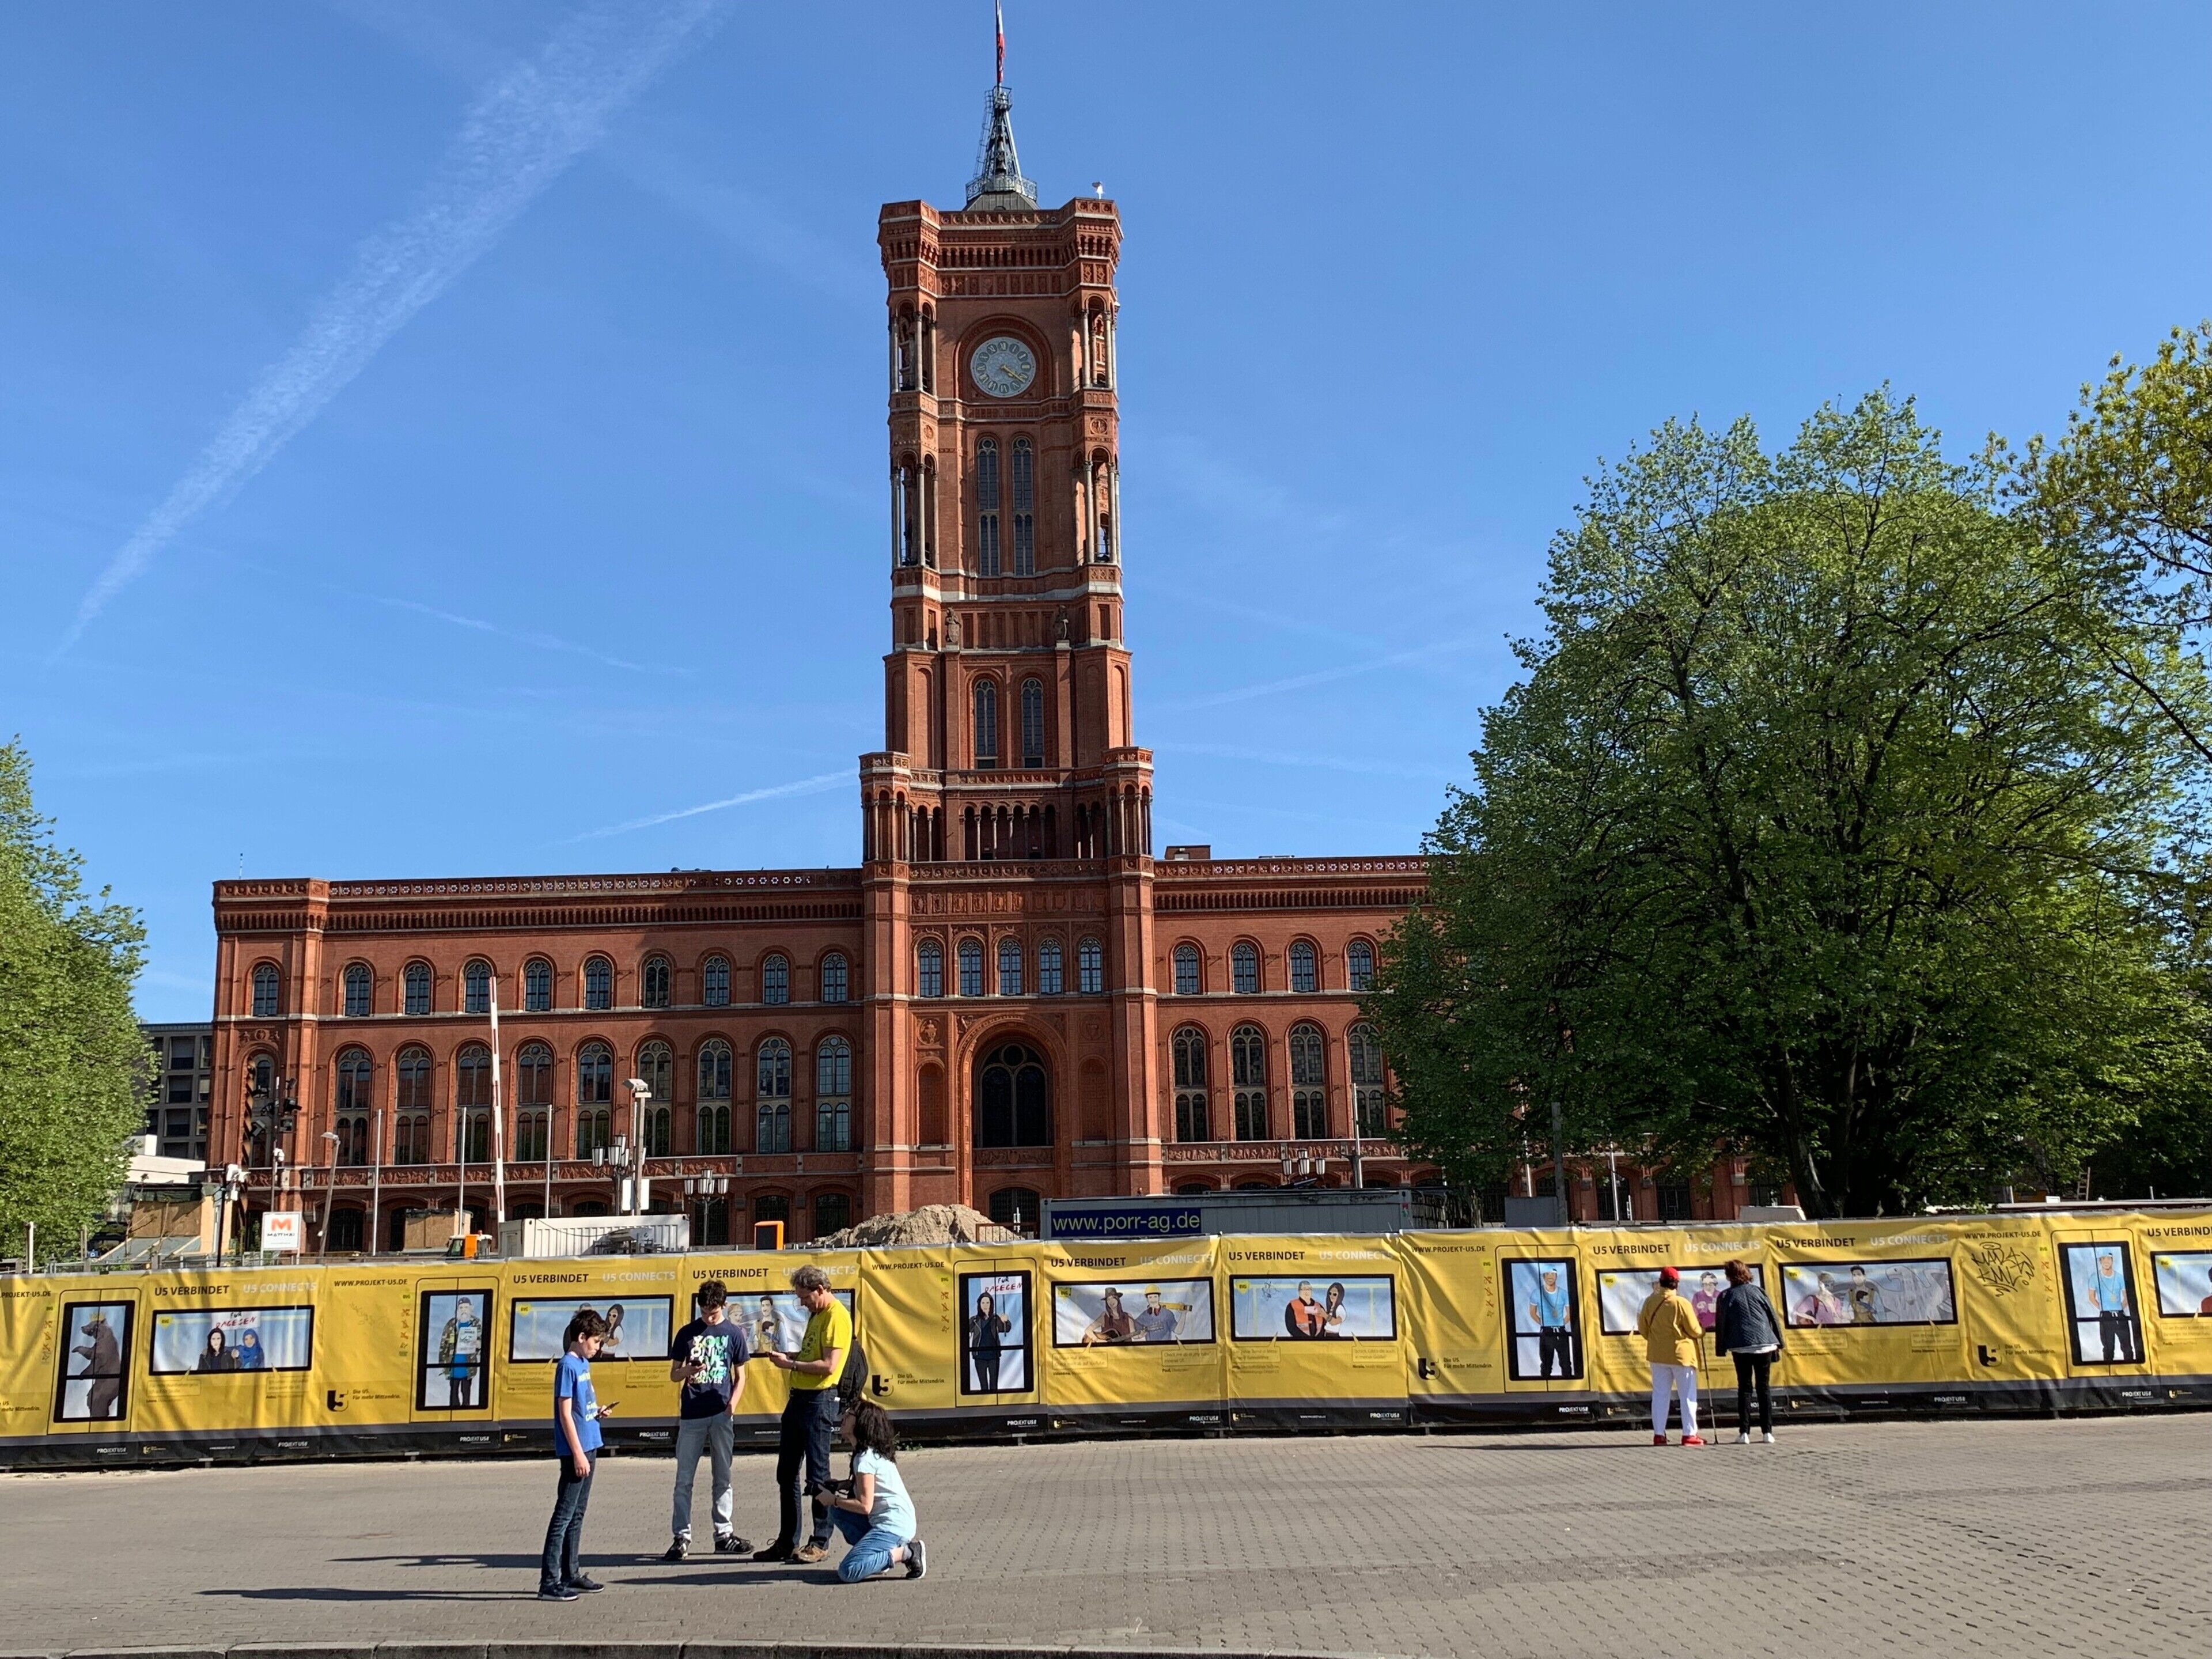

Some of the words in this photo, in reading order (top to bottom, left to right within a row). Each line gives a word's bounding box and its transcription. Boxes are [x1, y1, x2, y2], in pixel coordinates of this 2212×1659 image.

[1053, 1211, 1200, 1232] www.porr-ag.de
[1965, 1231, 2041, 1239] WWW.PROJEKT-U5.DE
[2147, 1228, 2161, 1237] U5
[1777, 1240, 1791, 1248] U5
[1793, 1237, 1855, 1248] VERBINDET
[1870, 1237, 1885, 1246] U5
[1887, 1234, 1948, 1245] CONNECTS
[1411, 1245, 1486, 1253] WWW.PROJEKT-U5.DE
[1593, 1246, 1607, 1255] U5
[1609, 1244, 1670, 1254] VERBINDET
[1684, 1243, 1699, 1252] U5
[1701, 1241, 1760, 1252] CONNECTS
[1140, 1256, 1154, 1265] U5
[1156, 1254, 1213, 1264] CONNECTS
[1229, 1252, 1243, 1260] U5
[1245, 1251, 1305, 1260] VERBINDET
[1319, 1252, 1333, 1260] U5
[1336, 1251, 1393, 1260] CONNECTS
[872, 1262, 944, 1270] WWW.PROJEKT-U5.DE
[1051, 1258, 1065, 1267] U5
[1066, 1257, 1126, 1267] VERBINDET
[513, 1275, 527, 1283] U5
[529, 1274, 589, 1283] VERBINDET
[602, 1273, 616, 1282] U5
[619, 1271, 676, 1281] CONNECTS
[692, 1270, 706, 1279] U5
[709, 1268, 768, 1278] VERBINDET
[154, 1287, 168, 1296] U5
[170, 1285, 229, 1295] VERBINDET
[244, 1284, 257, 1293] U5
[259, 1282, 317, 1292] CONNECTS
[693, 1335, 729, 1349] YOU
